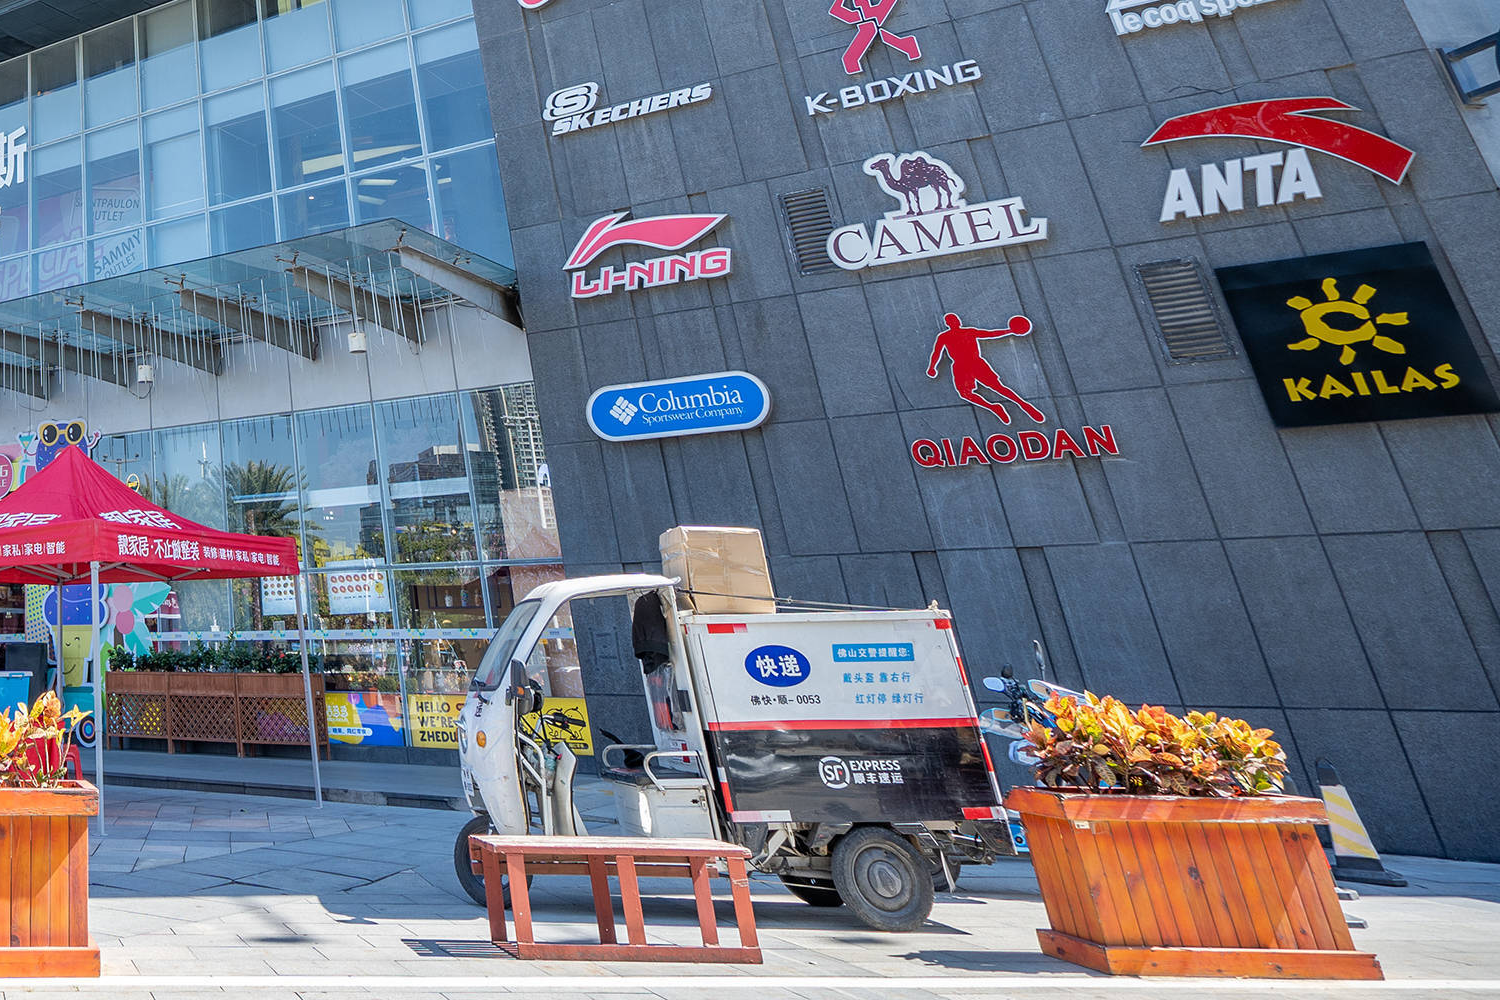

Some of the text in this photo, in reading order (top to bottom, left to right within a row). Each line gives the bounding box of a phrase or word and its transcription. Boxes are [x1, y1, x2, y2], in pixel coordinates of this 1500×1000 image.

[805, 59, 982, 116] K-BOXING
[552, 82, 713, 137] SKECHERS
[1159, 148, 1323, 223] ANTA
[95, 210, 124, 222] UTLET
[833, 203, 1041, 264] CAMEL
[94, 230, 141, 275] SAMMY
[575, 249, 729, 297] LI-NING
[1283, 363, 1460, 402] KAILAS
[638, 385, 744, 413] Columbia
[642, 406, 743, 426] Sportswear Company
[910, 424, 1120, 469] QIAODAN
[755, 654, 802, 677] 快递
[416, 701, 451, 712] HELLO
[855, 692, 924, 704] 红灯停 绿灯行
[418, 716, 454, 728] WE'RE
[850, 760, 900, 771] EXPRESS
[852, 772, 904, 785] 顺丰速运
